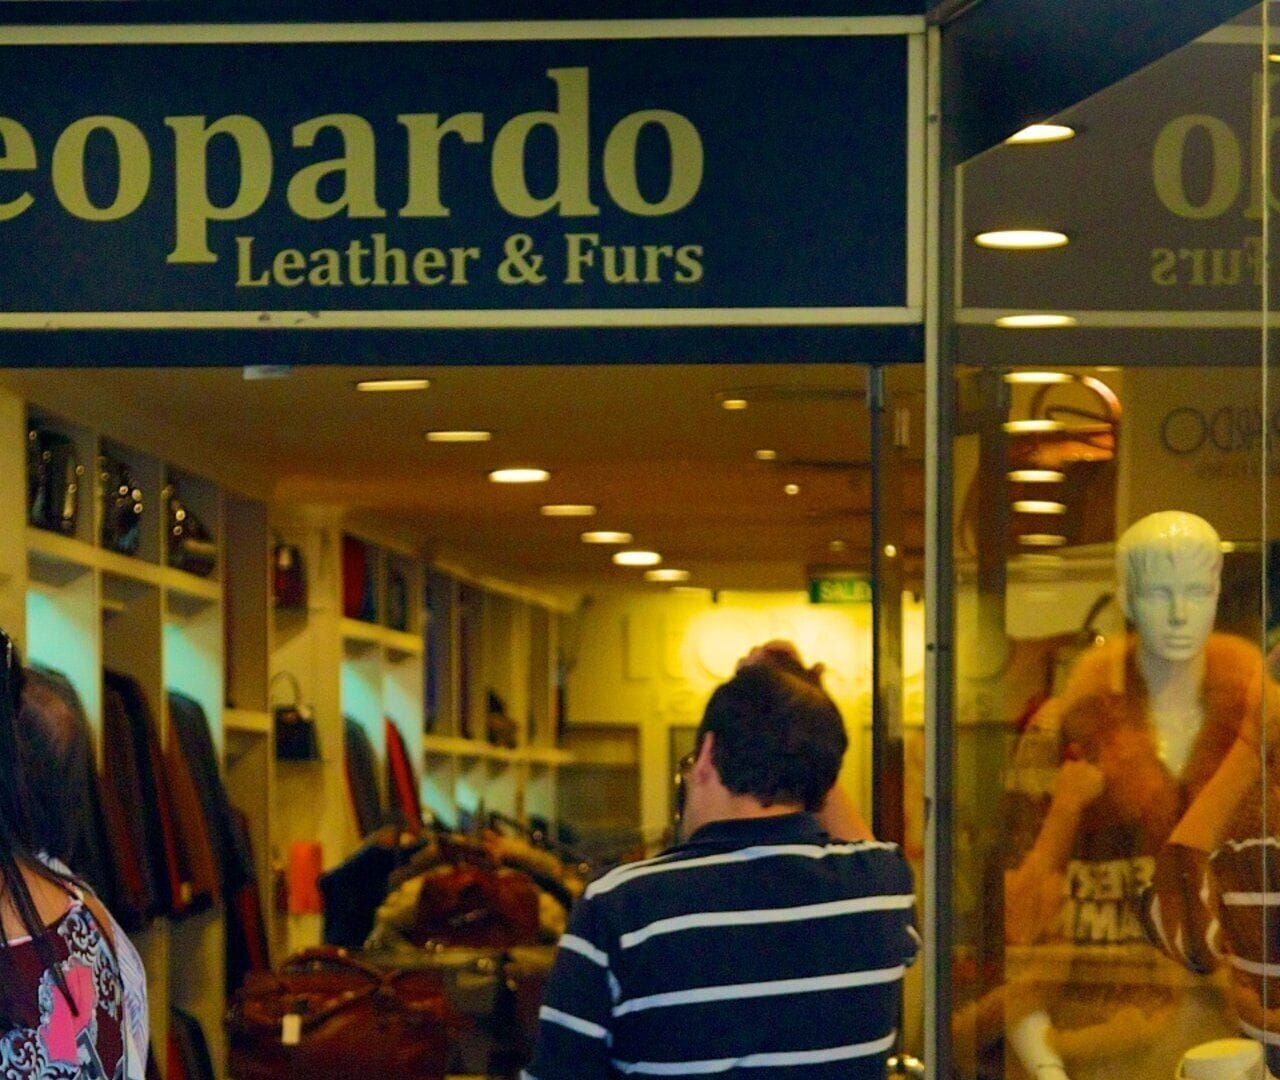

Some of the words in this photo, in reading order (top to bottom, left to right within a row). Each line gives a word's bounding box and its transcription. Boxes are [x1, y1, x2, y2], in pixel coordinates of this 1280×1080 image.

[235, 233, 480, 288] Leather
[497, 233, 546, 285] &
[565, 233, 704, 285] Furs
